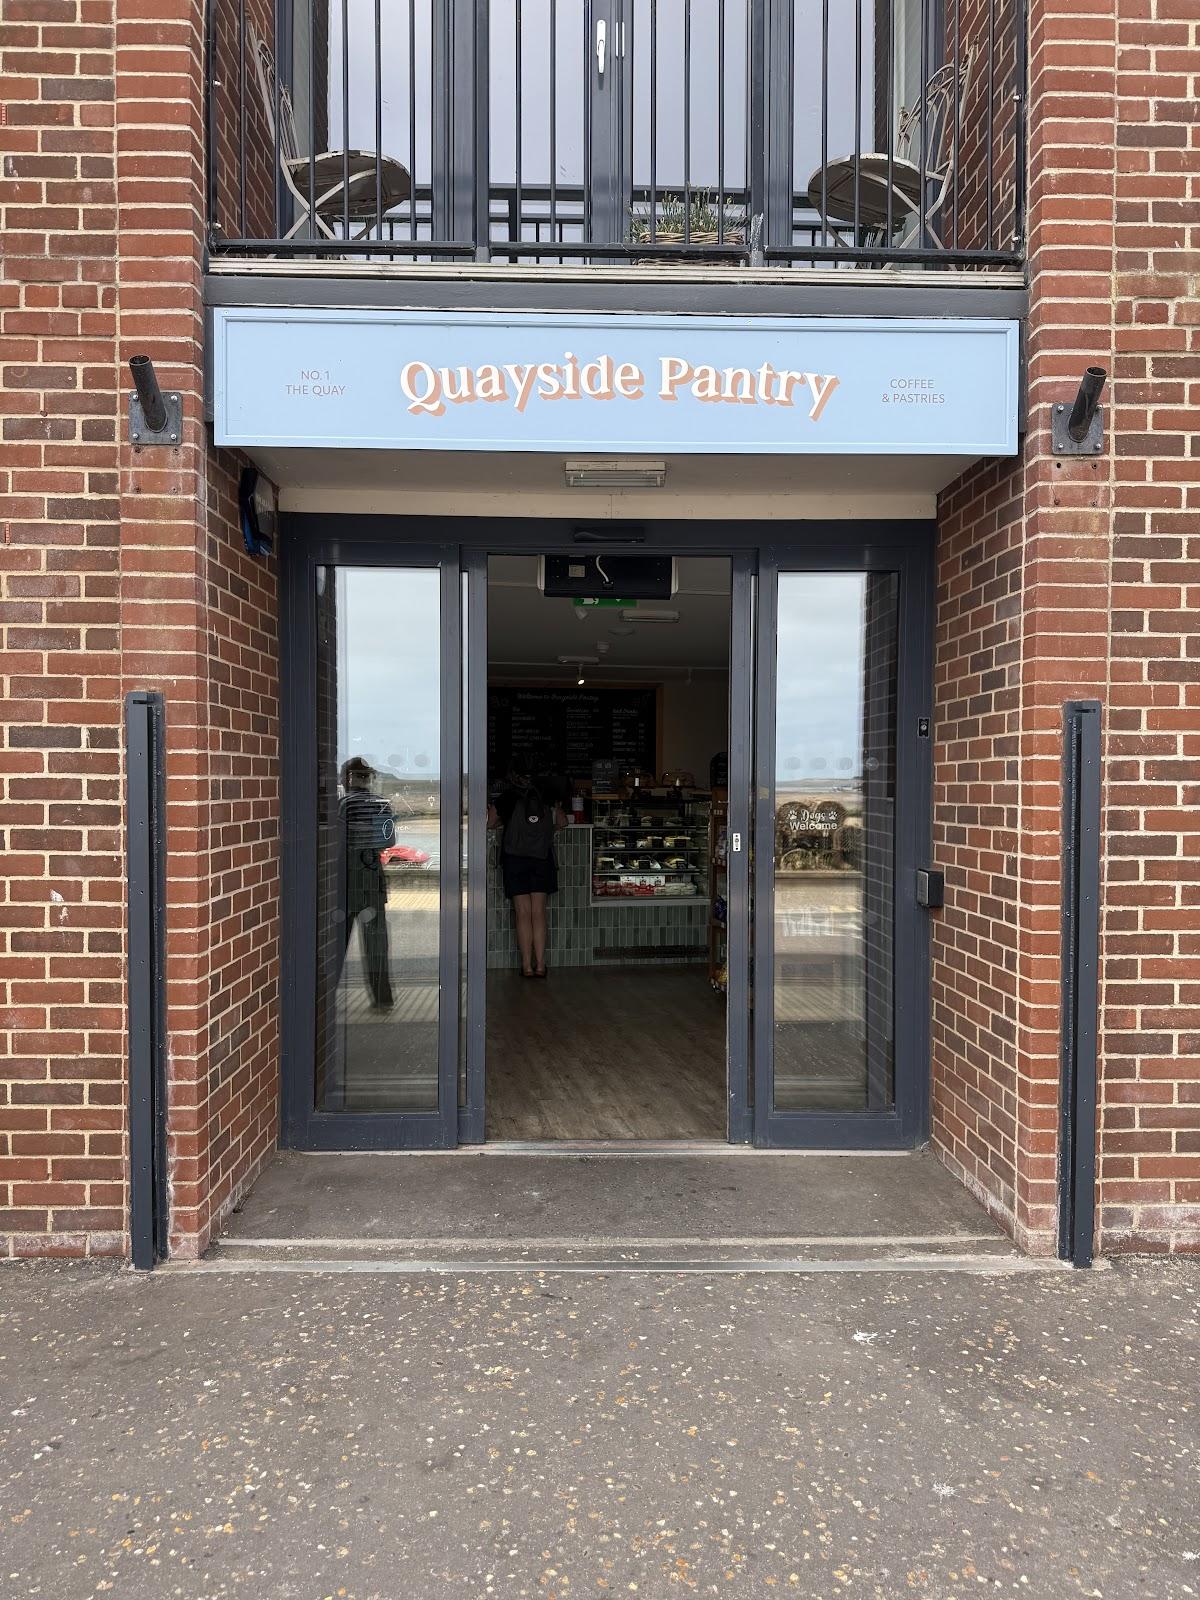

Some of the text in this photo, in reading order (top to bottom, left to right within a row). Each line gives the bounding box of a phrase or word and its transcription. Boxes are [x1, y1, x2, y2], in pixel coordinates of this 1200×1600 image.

[399, 351, 840, 421] Quayside Pantry
[890, 378, 935, 389] COFFEE
[285, 384, 346, 397] THE QUAY
[881, 393, 945, 404] & PASTRIES
[800, 809, 826, 823] Dogs
[790, 821, 838, 831] Welcome
